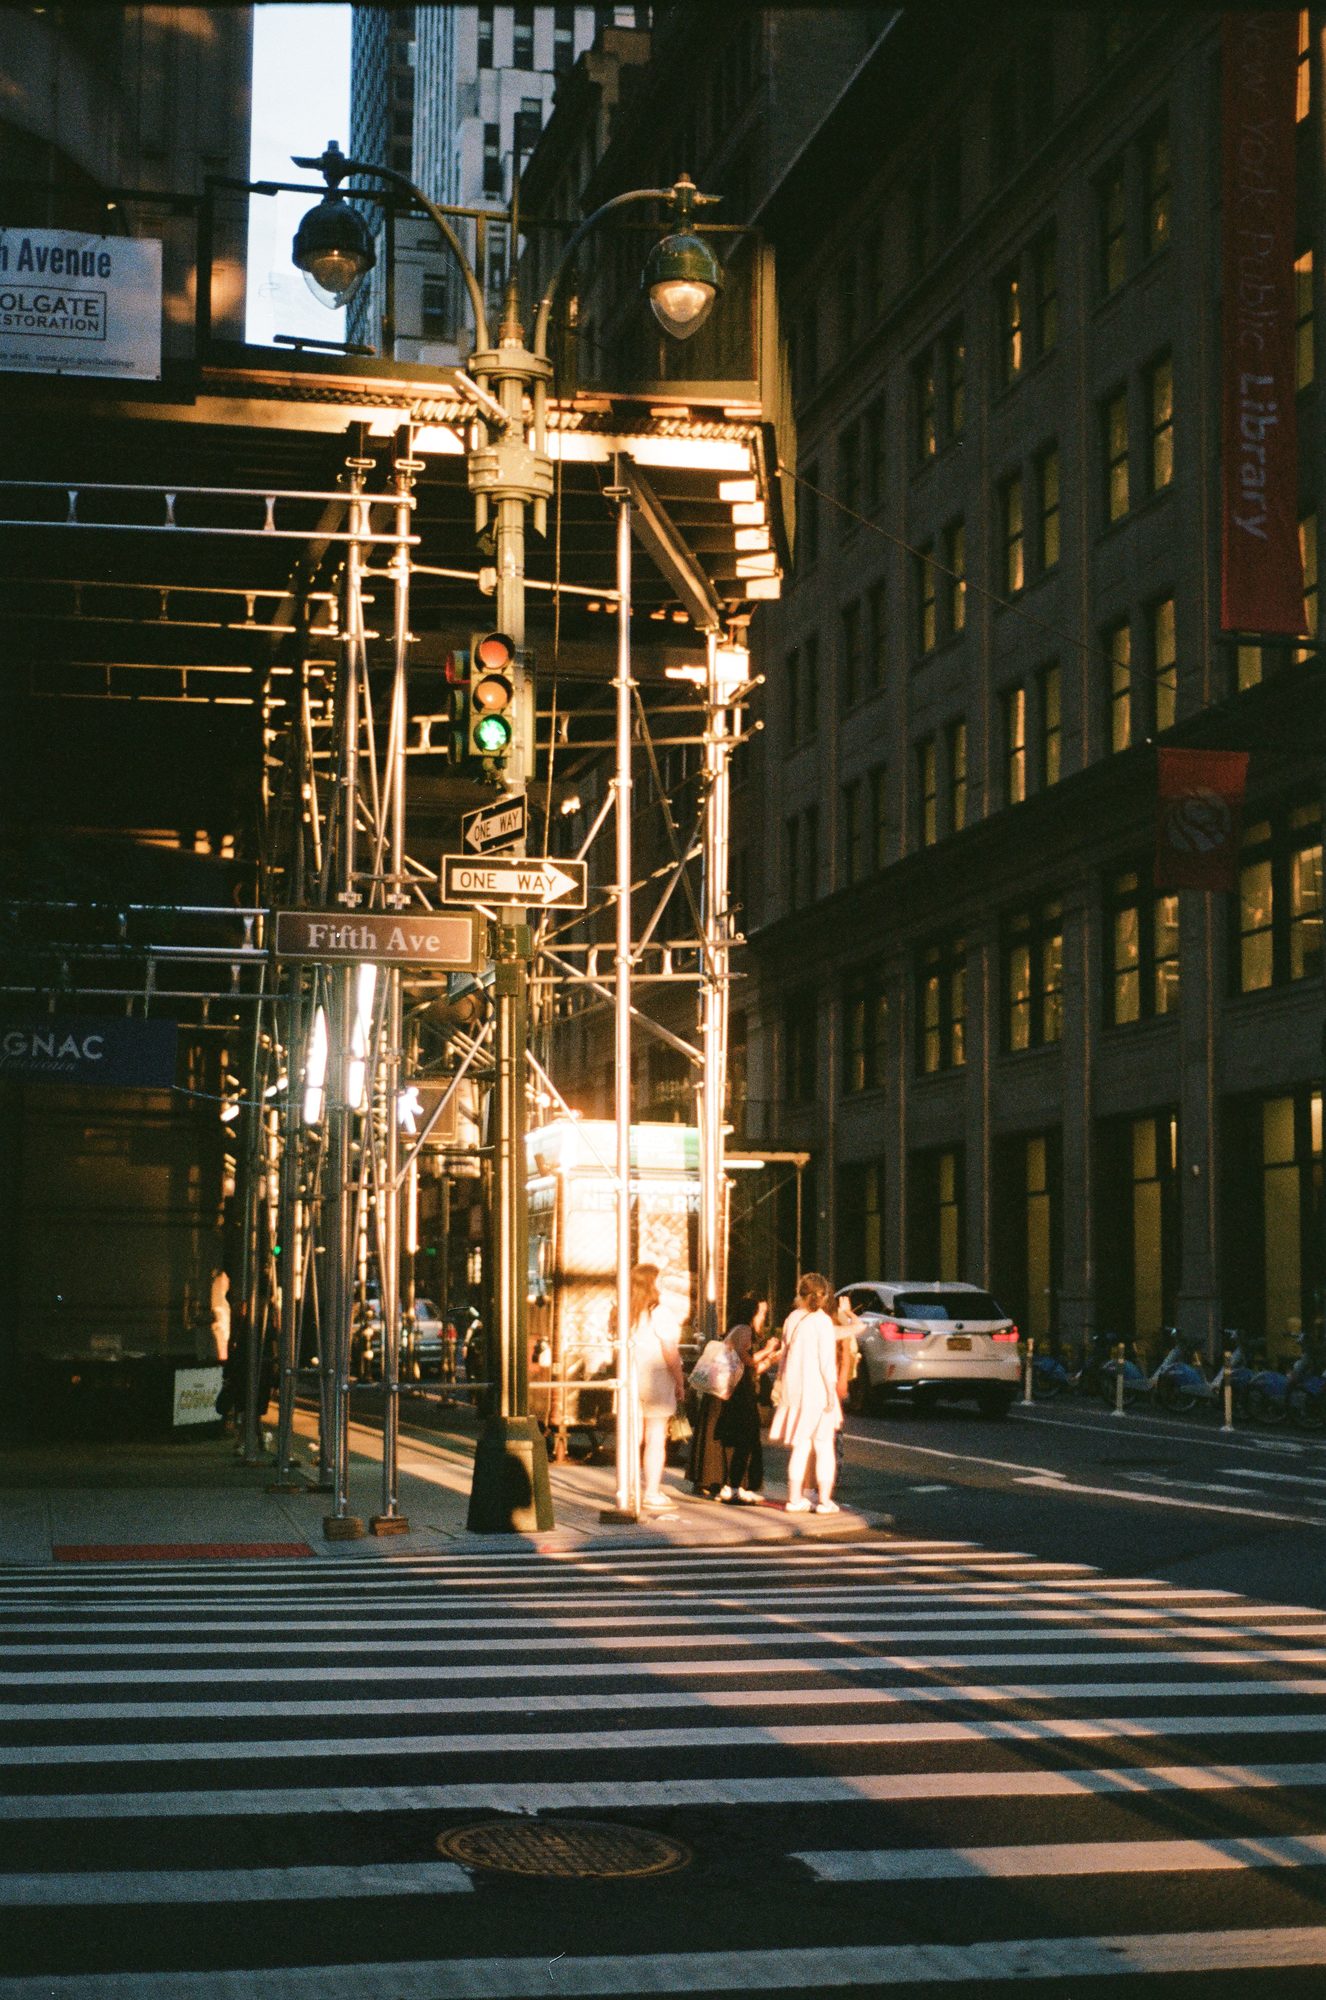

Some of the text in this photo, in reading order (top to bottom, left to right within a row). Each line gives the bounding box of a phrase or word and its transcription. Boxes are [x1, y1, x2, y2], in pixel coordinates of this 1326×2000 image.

[1240, 119, 1278, 207] York
[17, 237, 112, 278] Avenue
[1239, 229, 1279, 352] Public
[0, 312, 99, 332] STORATION
[1234, 371, 1278, 539] Library
[474, 810, 520, 842] ONE WAY
[460, 871, 557, 892] ONE WAY
[307, 923, 441, 953] Fifth Ave
[3, 1031, 104, 1059] GNAC
